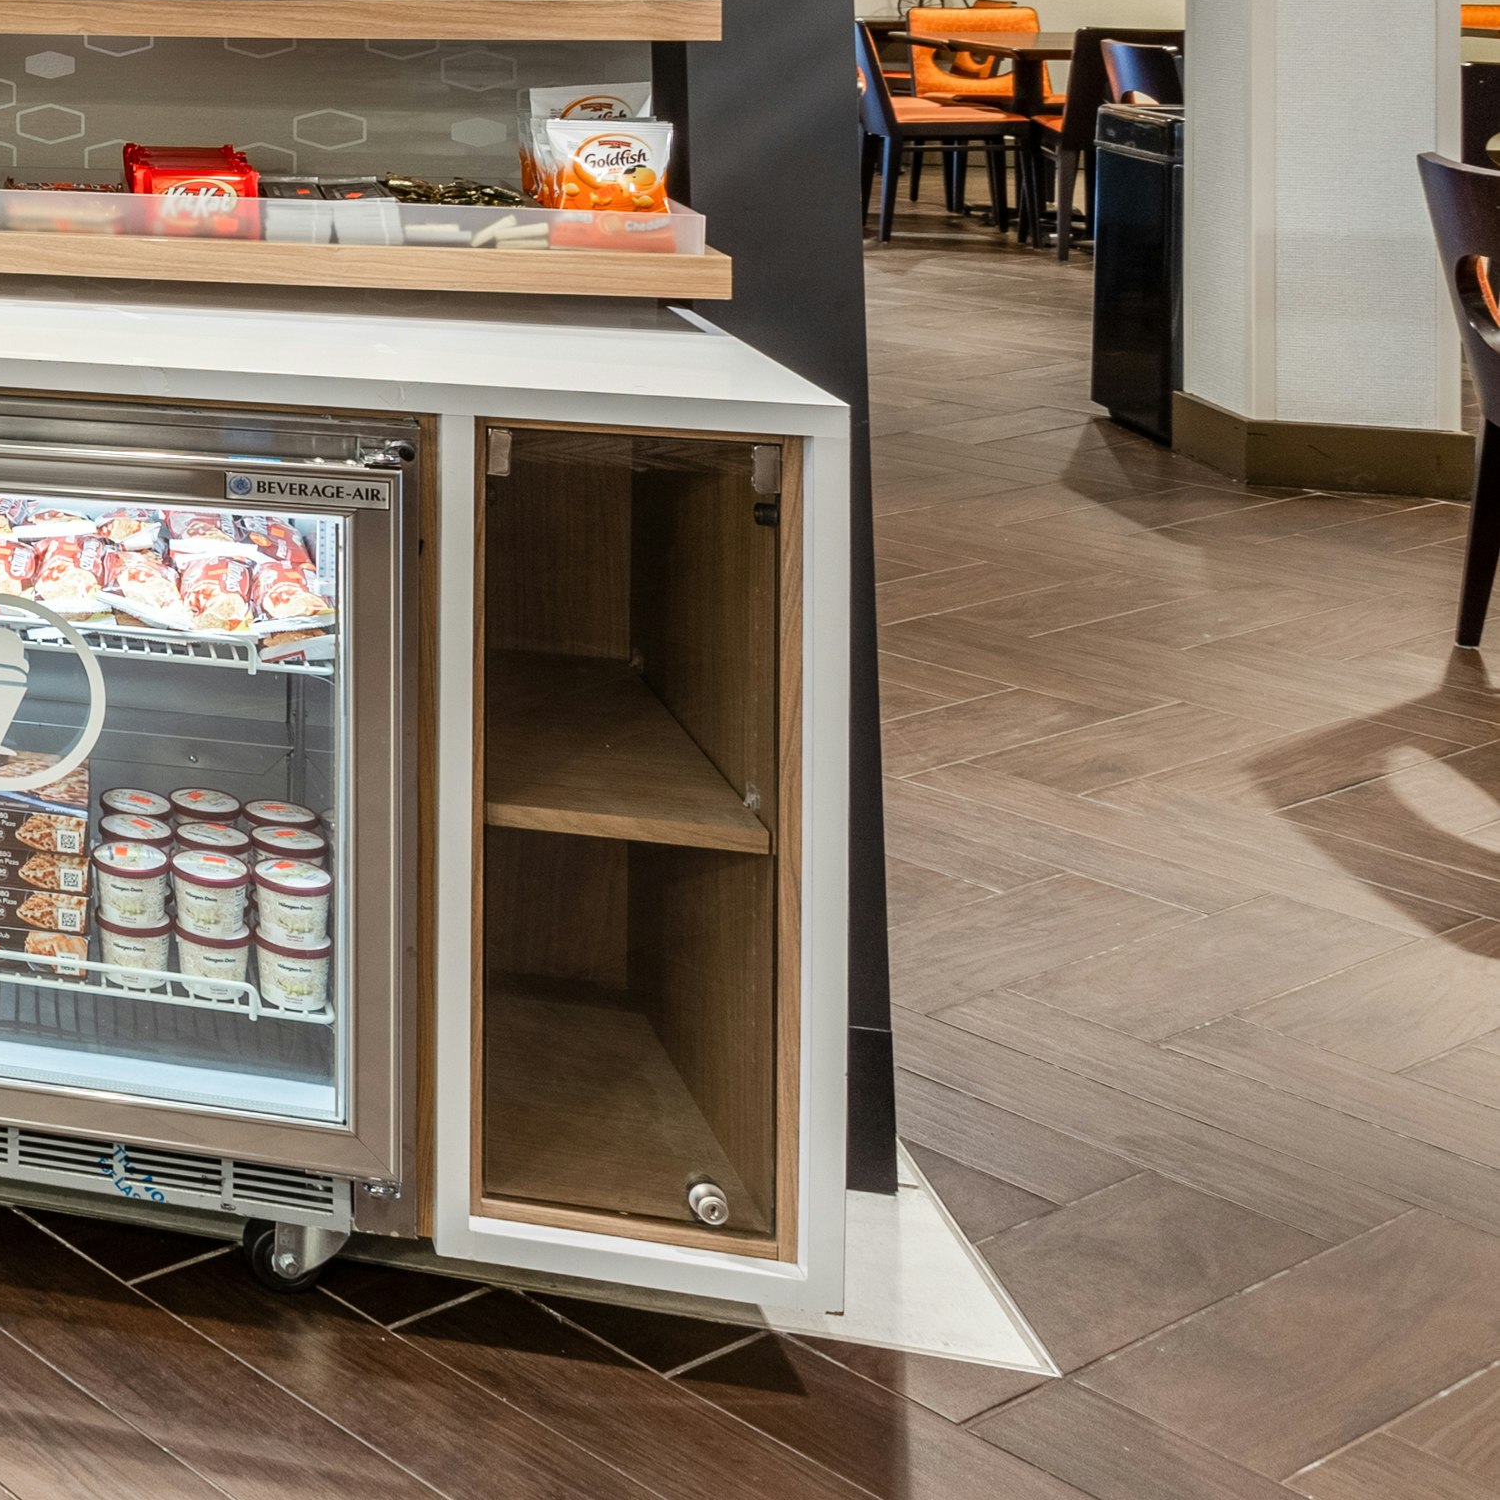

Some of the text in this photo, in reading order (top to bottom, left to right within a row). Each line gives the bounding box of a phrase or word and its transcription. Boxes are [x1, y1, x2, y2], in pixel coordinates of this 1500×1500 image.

[584, 148, 647, 168] Goldfish
[257, 480, 382, 503] BEVERAGE-AIR
[1, 820, 16, 829] Pizza
[4, 859, 19, 868] Pizza
[2, 898, 17, 907] Pizza
